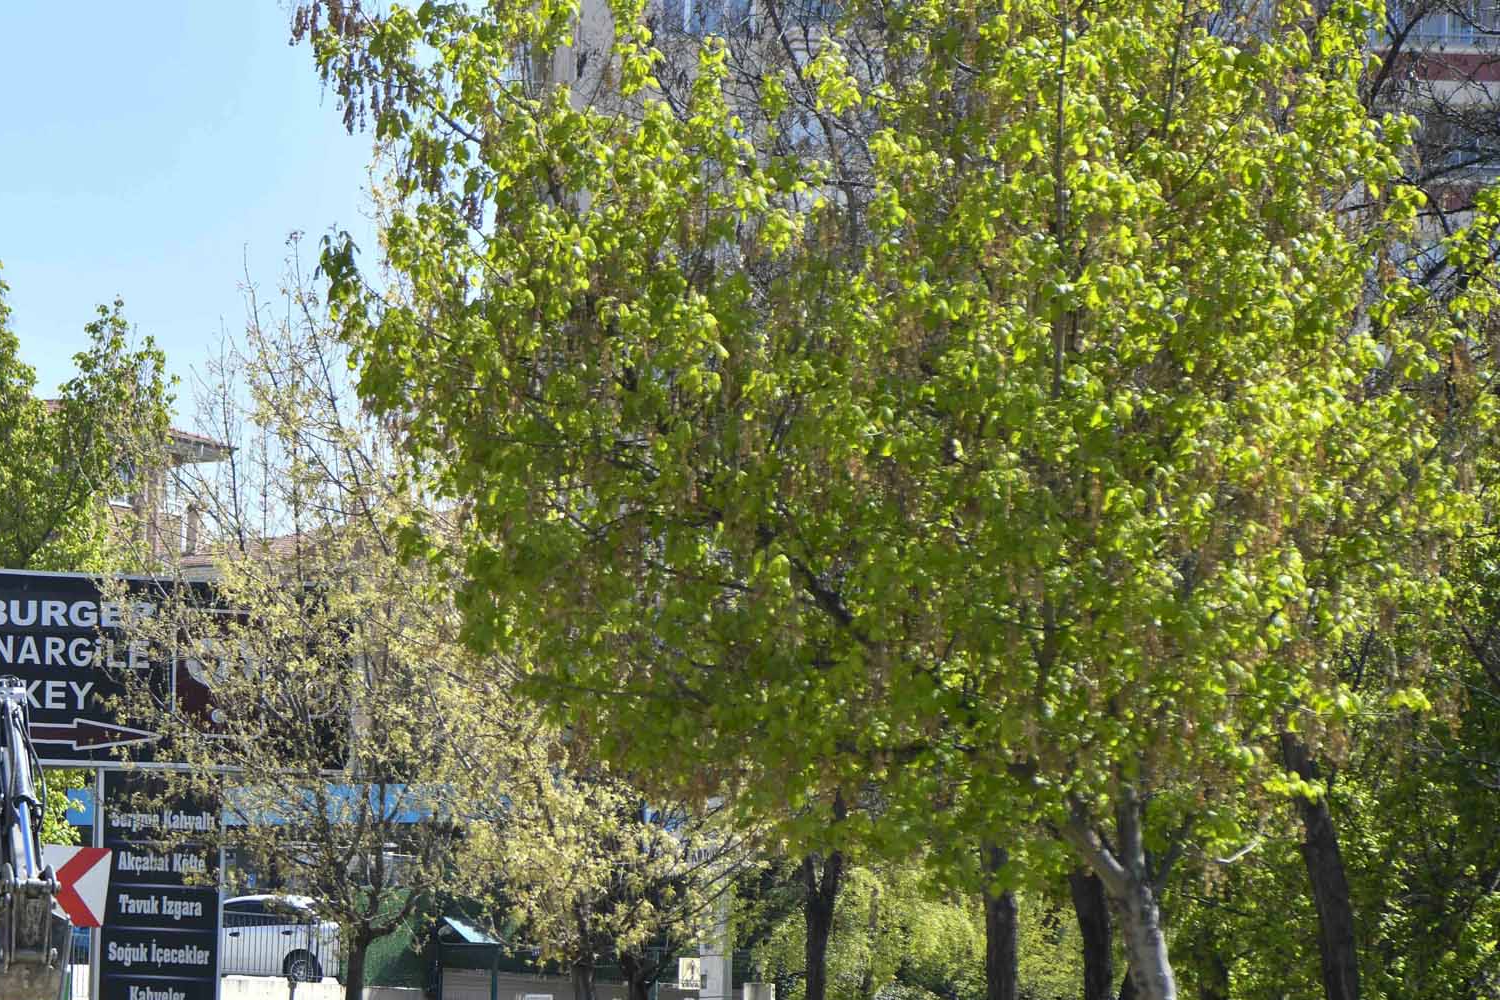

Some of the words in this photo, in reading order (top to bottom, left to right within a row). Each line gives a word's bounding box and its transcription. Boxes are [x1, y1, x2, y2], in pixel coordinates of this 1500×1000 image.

[118, 893, 159, 915] Tavuk
[162, 895, 202, 920] Izgara
[108, 941, 148, 967] Soğuk
[151, 938, 210, 968] İçecekler
